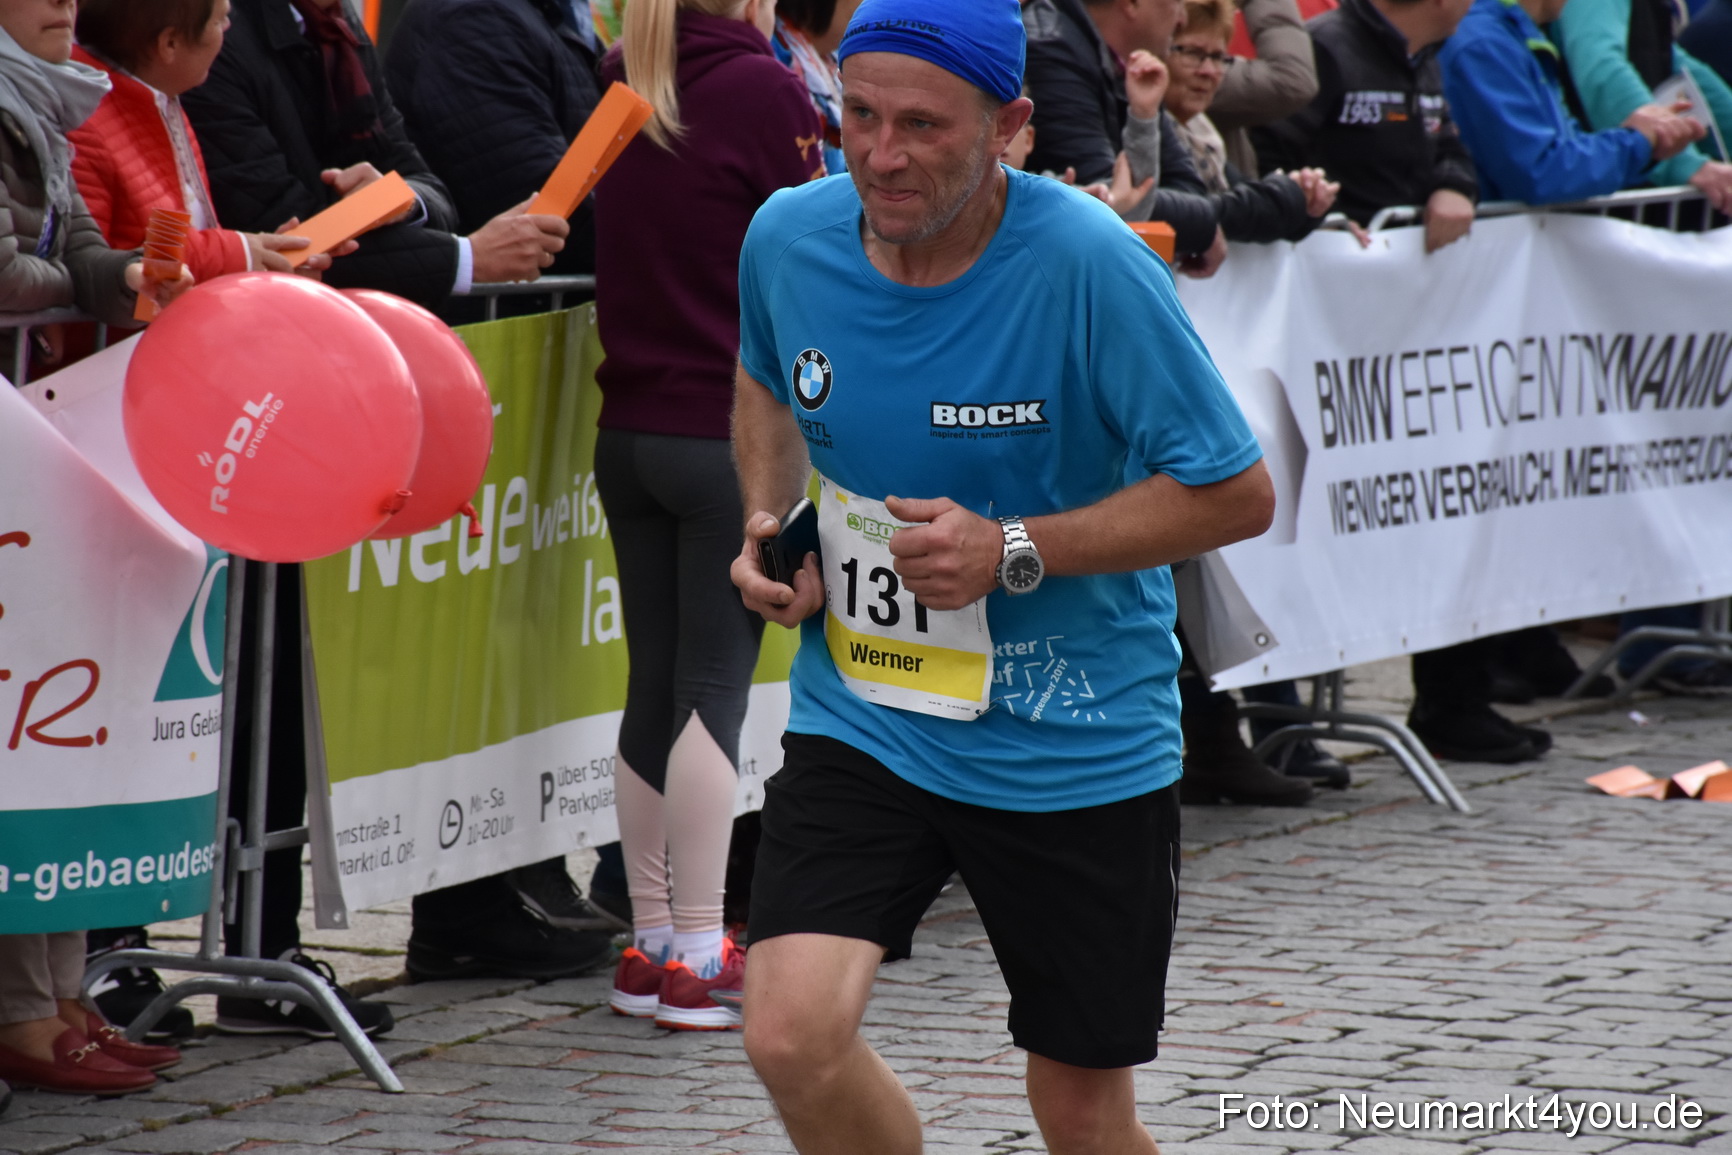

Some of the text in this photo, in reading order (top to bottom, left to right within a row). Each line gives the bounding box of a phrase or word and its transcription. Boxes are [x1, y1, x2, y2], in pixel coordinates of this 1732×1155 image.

[797, 350, 831, 374] BMW
[931, 400, 1047, 429] BOCK
[1315, 353, 1393, 449] BMW
[245, 399, 284, 459] energie
[930, 425, 1052, 441] inspired by smart concepts
[196, 391, 274, 515] RÖDL
[1327, 470, 1420, 536] WENIGER
[863, 517, 902, 540] BO
[841, 557, 929, 634] 131
[850, 641, 923, 673] Werner
[1051, 657, 1068, 683] 2017
[153, 716, 185, 741] Jura
[557, 765, 588, 787] über
[393, 813, 402, 835] 1
